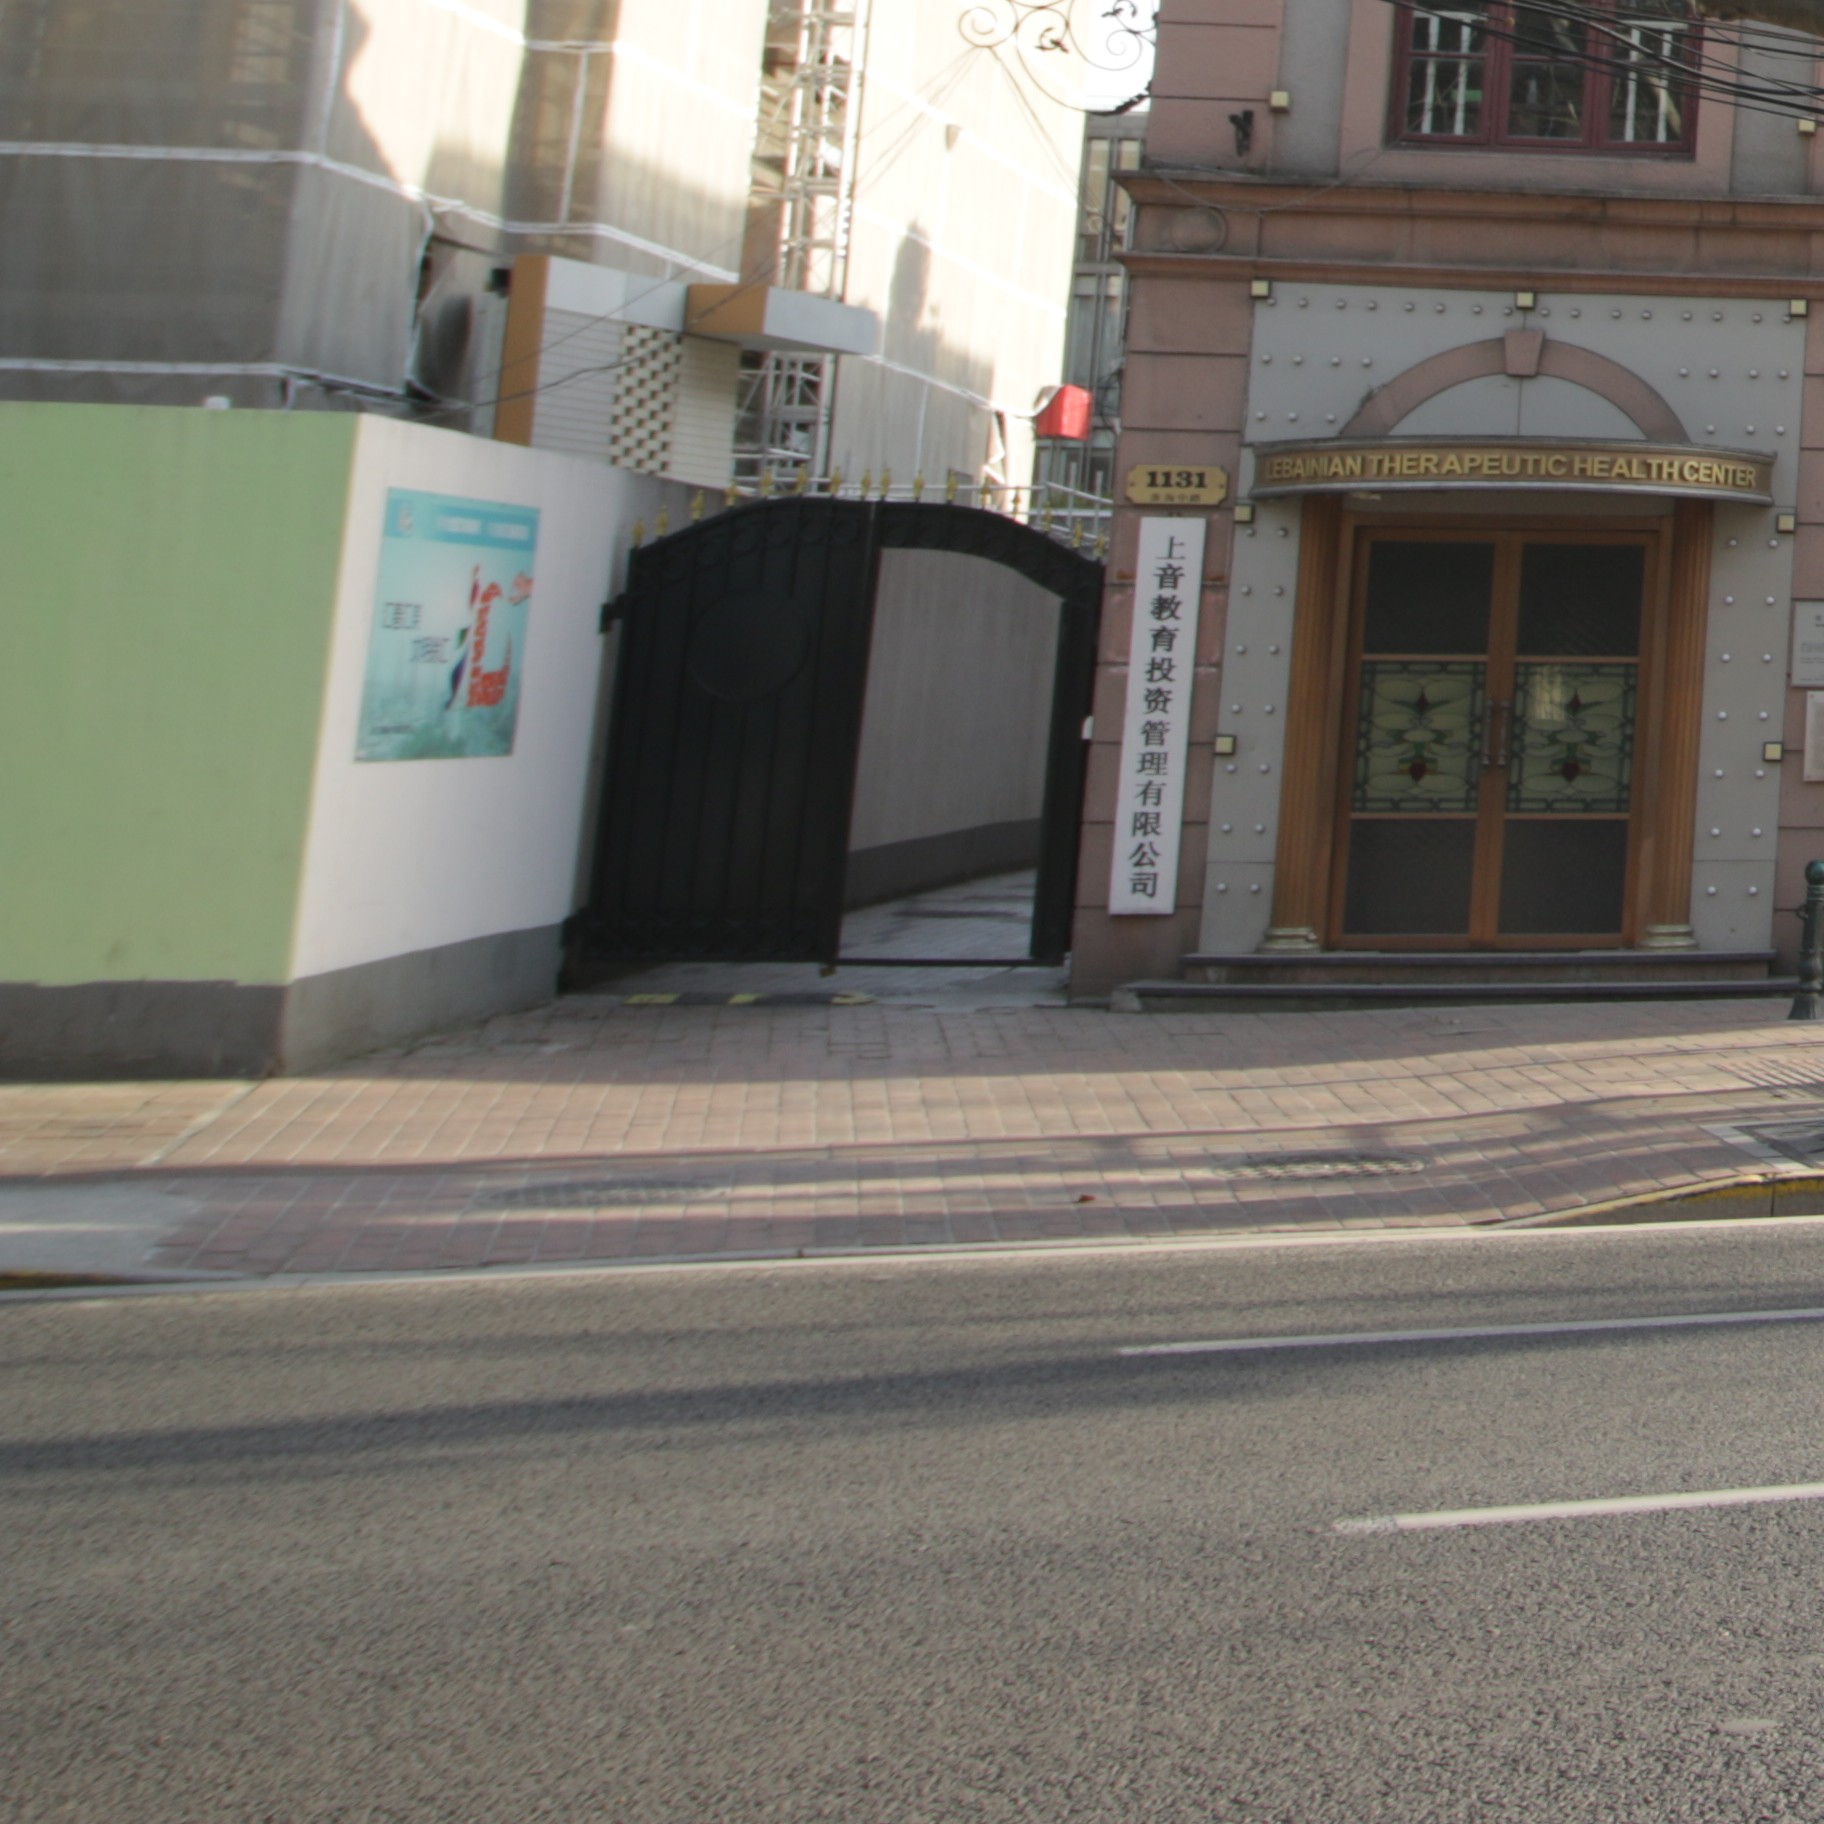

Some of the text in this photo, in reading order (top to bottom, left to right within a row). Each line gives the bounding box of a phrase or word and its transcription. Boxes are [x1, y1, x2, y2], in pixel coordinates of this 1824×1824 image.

[1146, 470, 1207, 489] 1131
[1266, 453, 1758, 488] LEBAINIAN THERAPEUTIC HEALTH CENTER
[1128, 535, 1187, 900] 上音教育投资管理有限公司
